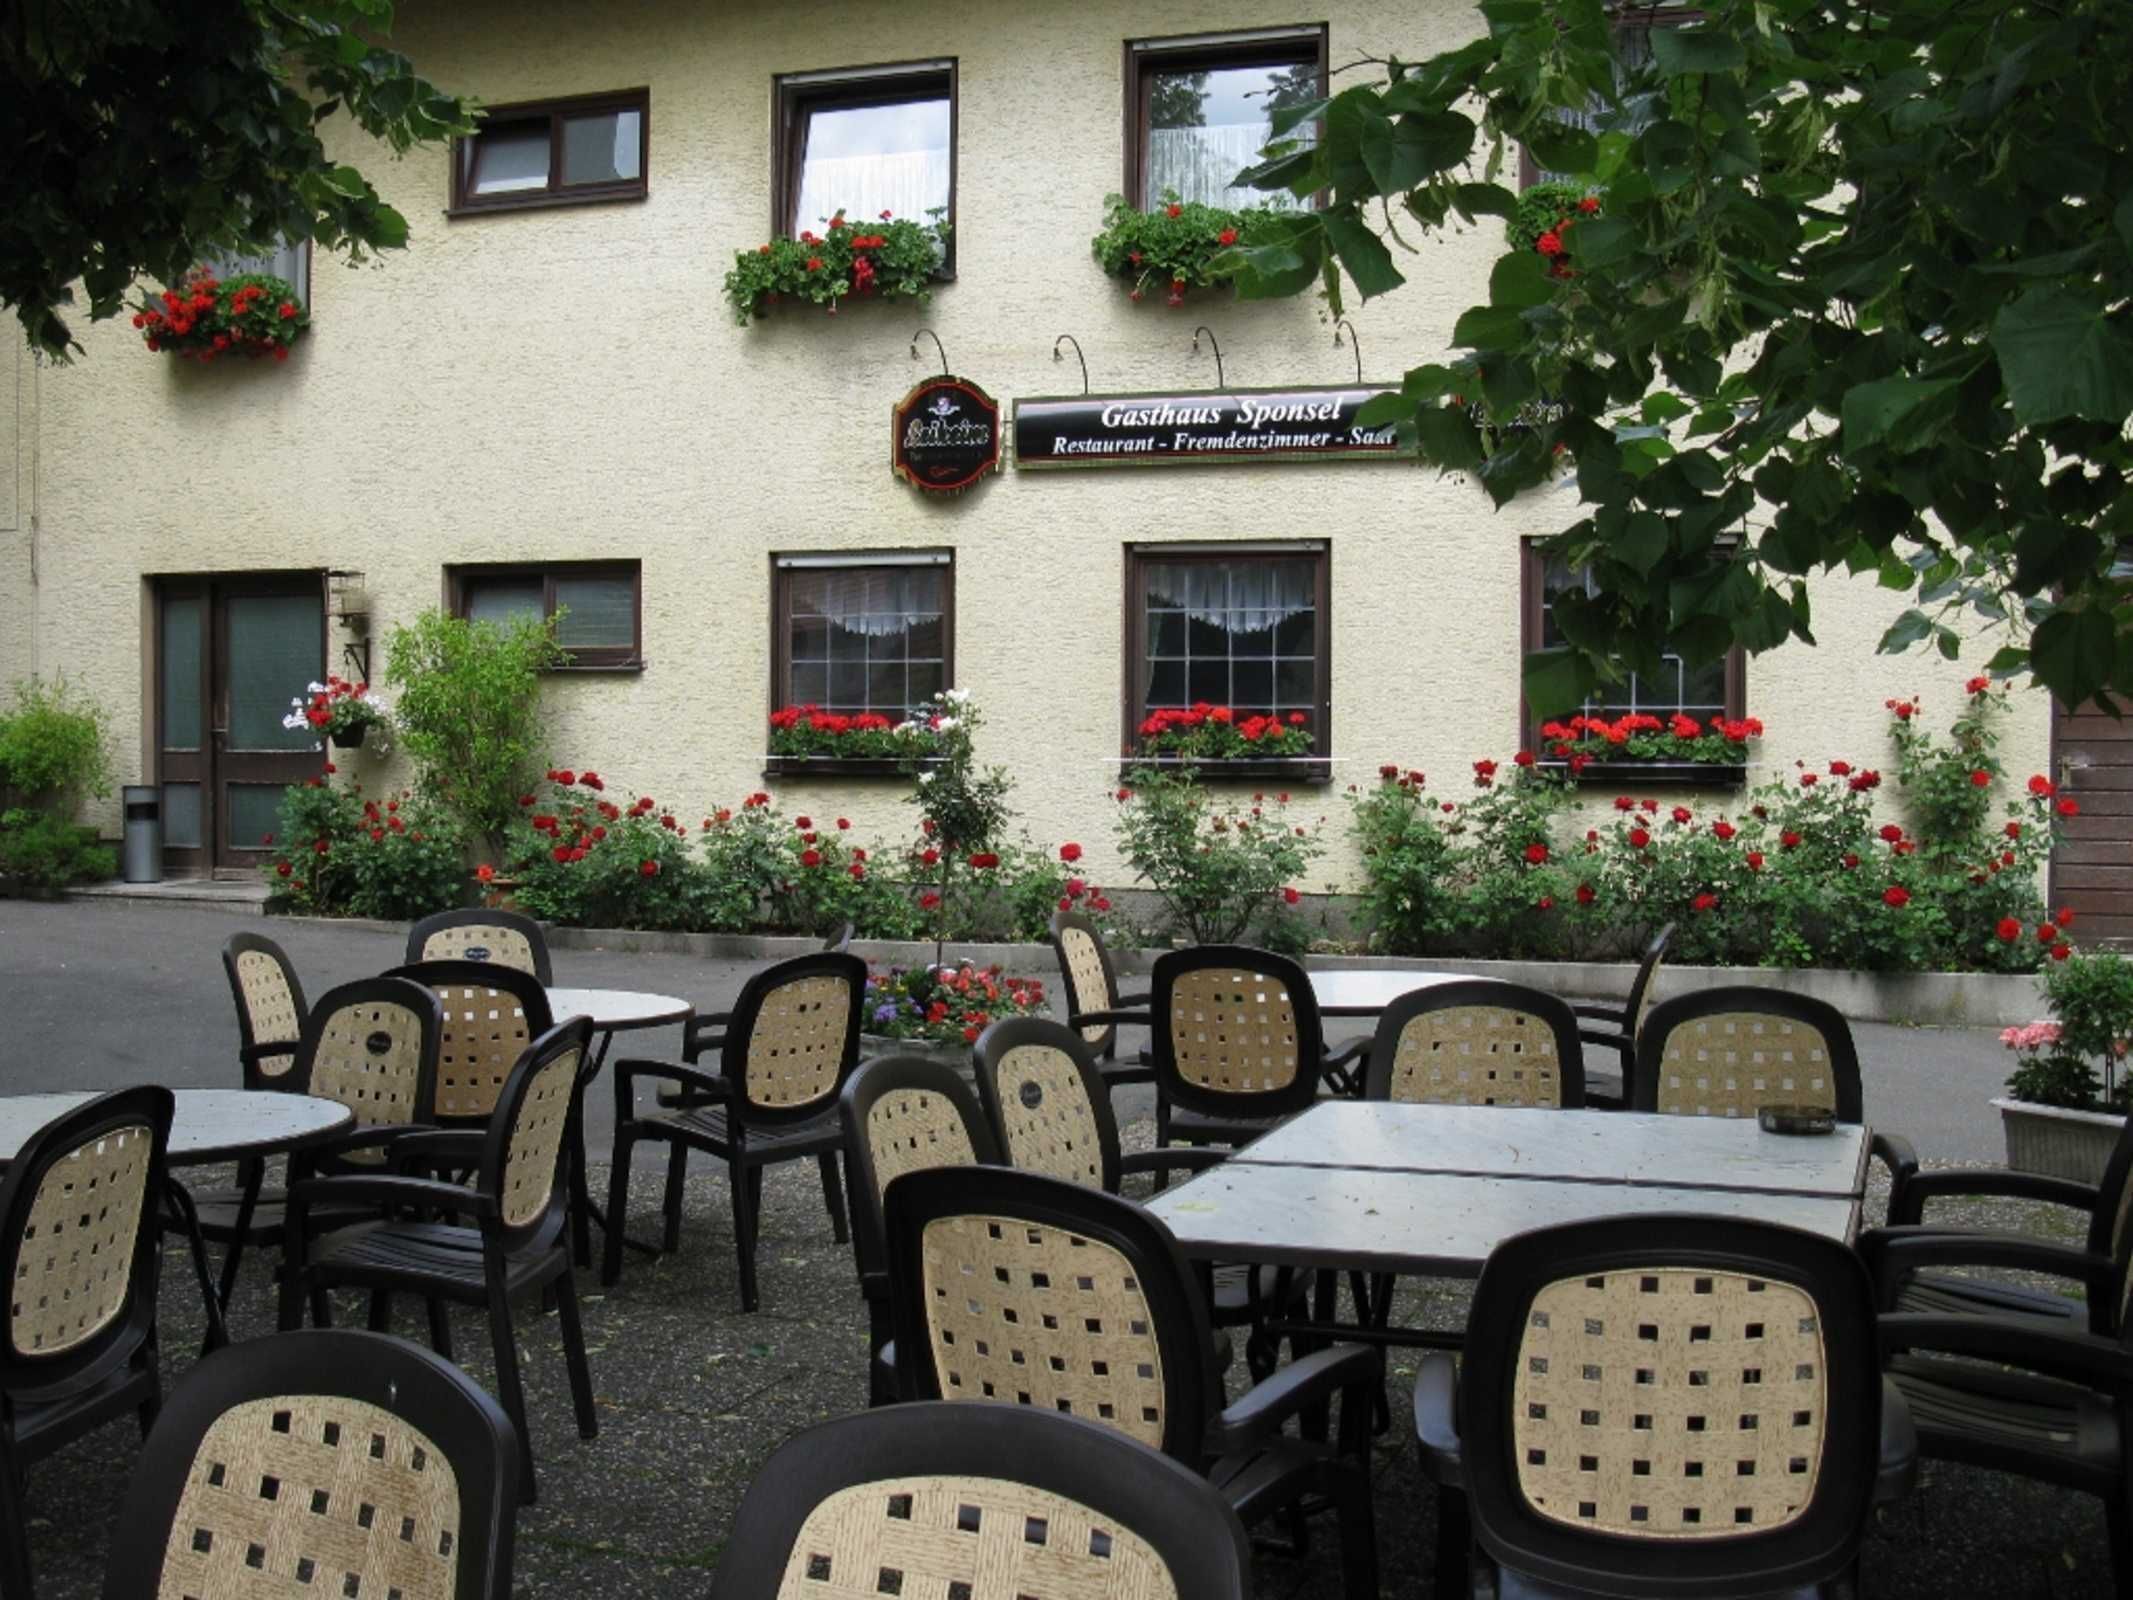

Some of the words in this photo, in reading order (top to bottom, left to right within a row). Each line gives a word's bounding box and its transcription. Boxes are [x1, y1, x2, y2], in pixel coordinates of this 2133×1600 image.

[1101, 402, 1222, 428] Gasthaus
[1236, 396, 1344, 430] Sponsel
[1051, 435, 1155, 456] Restaurant
[1173, 429, 1331, 451] Fremdenzimmer
